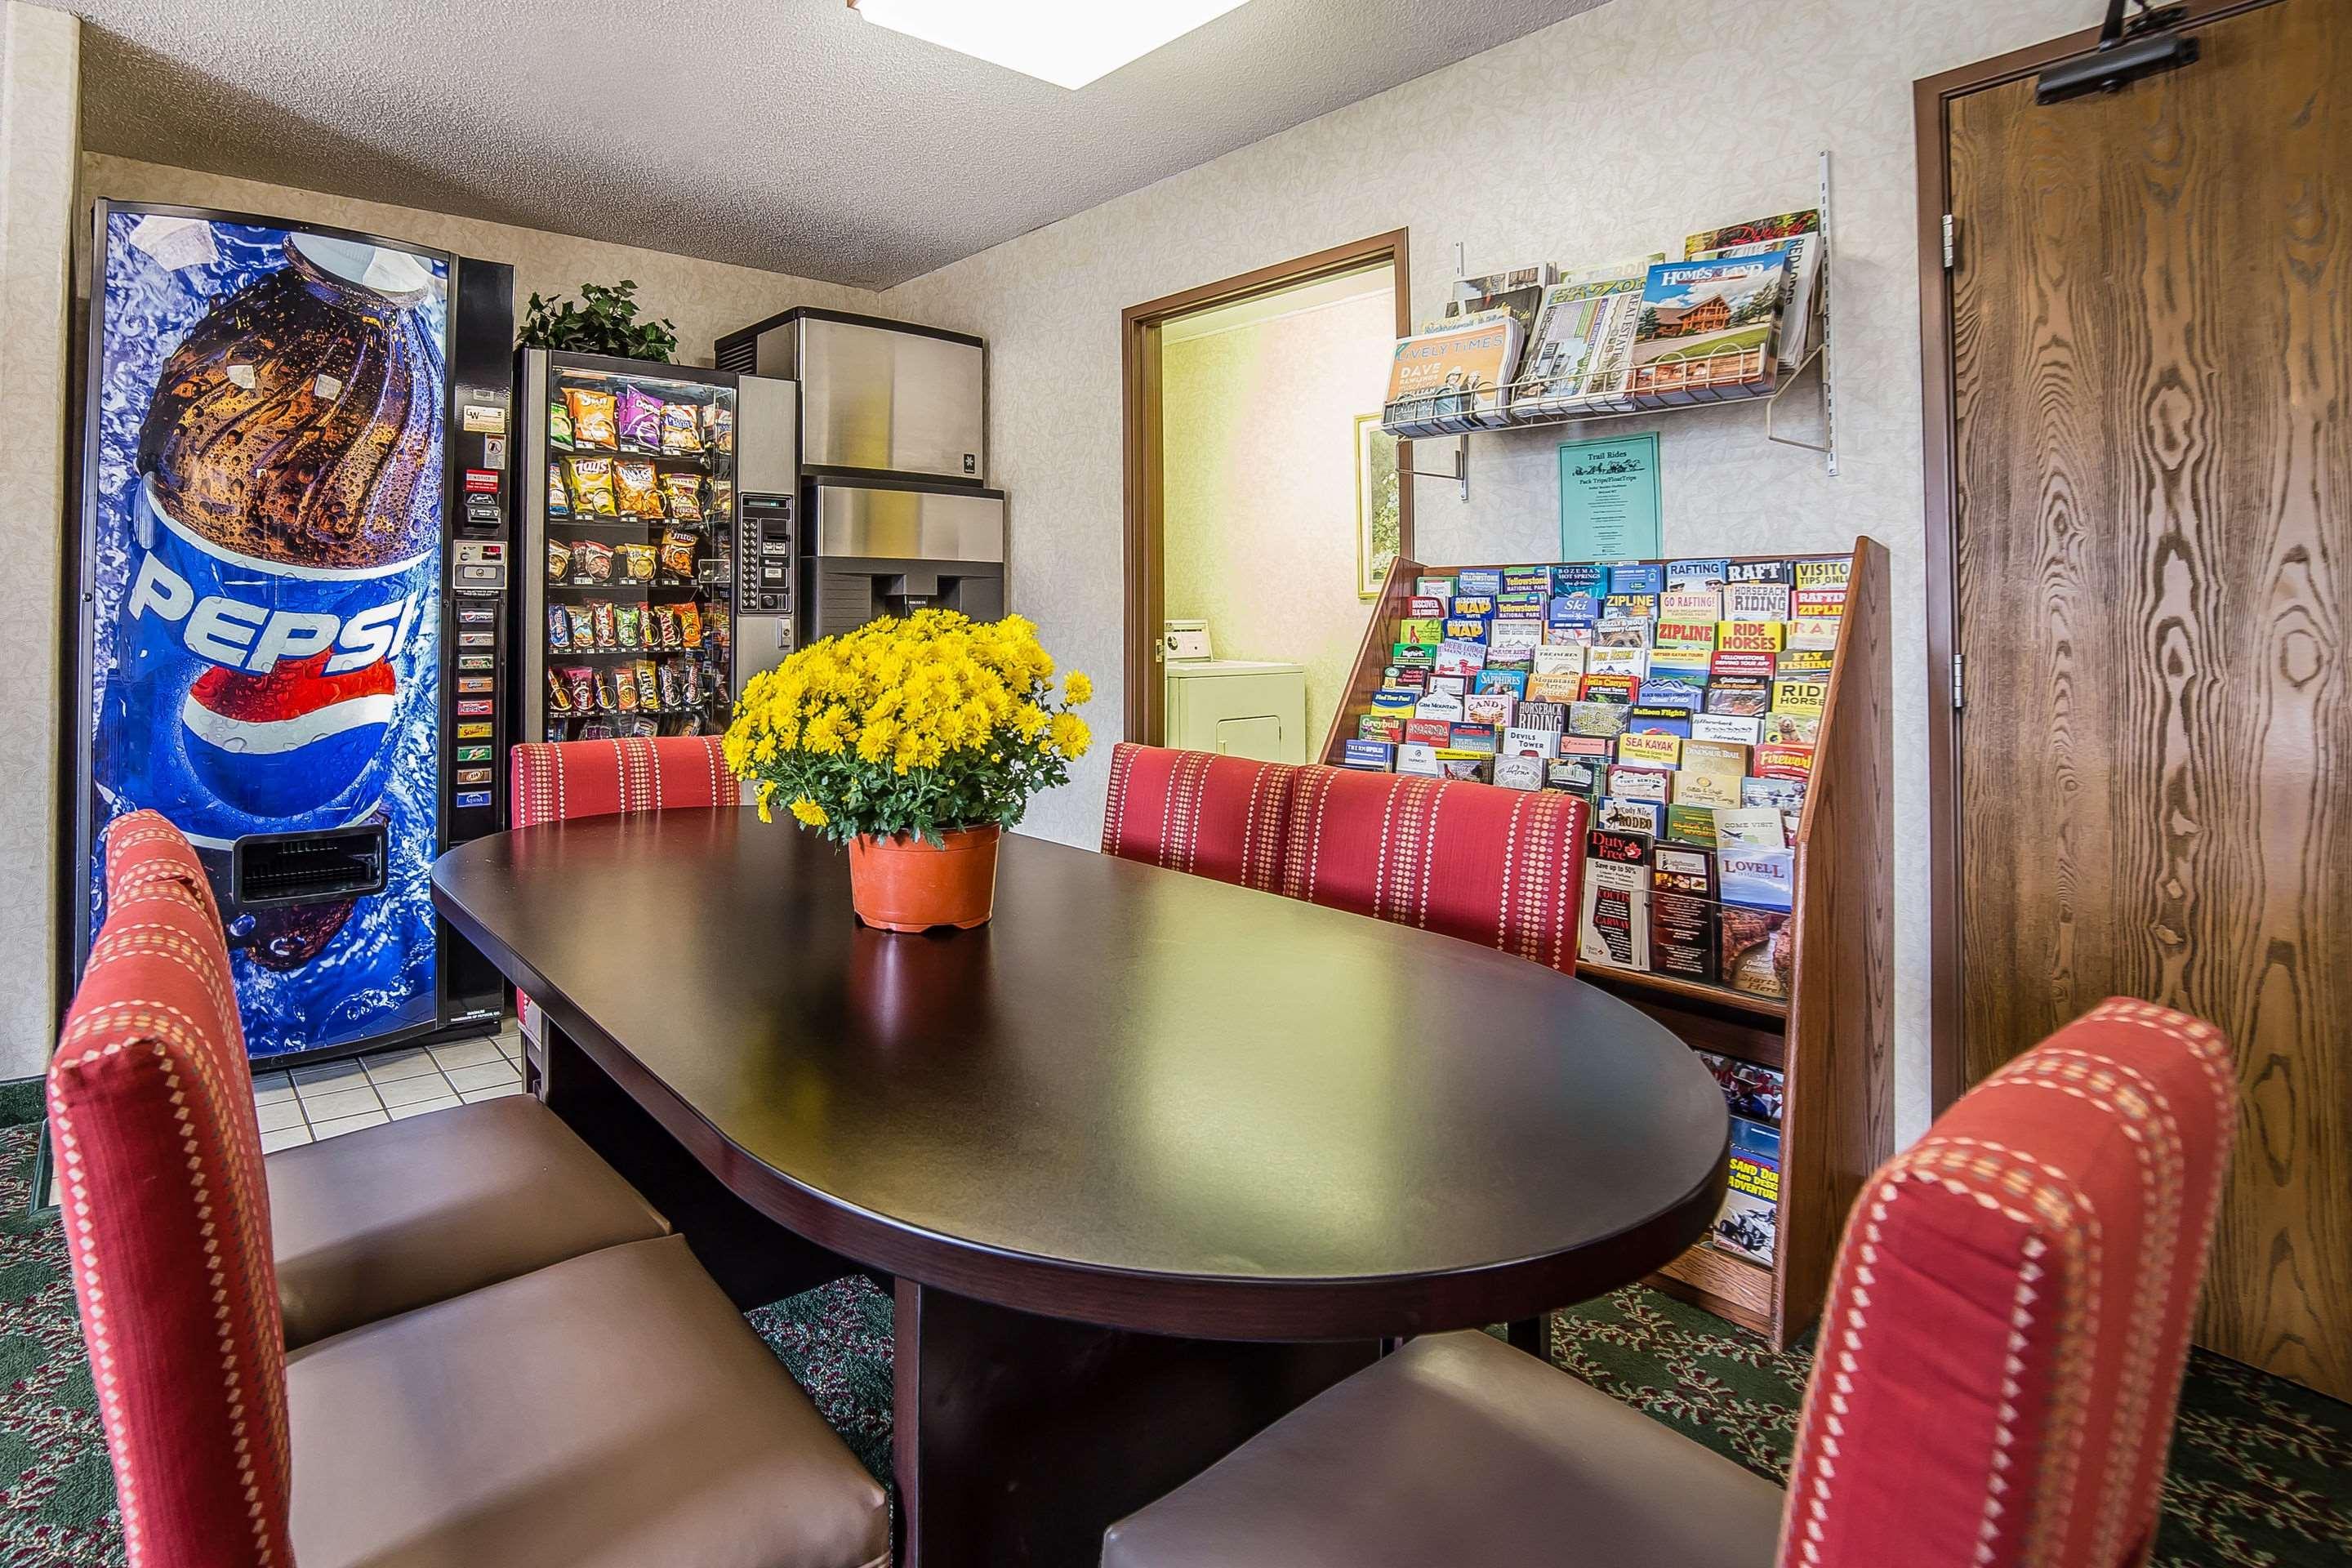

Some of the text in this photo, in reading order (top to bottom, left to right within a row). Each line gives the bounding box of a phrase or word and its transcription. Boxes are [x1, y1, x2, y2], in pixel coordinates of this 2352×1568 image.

[1660, 266, 1713, 287] HOMES
[1722, 263, 1765, 278] LAND
[1613, 294, 1641, 359] REAL ESTATE
[1401, 362, 1441, 379] DAVE
[1670, 564, 1719, 575] RAFTING
[1726, 562, 1781, 582] RAFT
[1506, 577, 1548, 586] Yellowstone
[1800, 577, 1820, 585] TIPS
[1734, 586, 1786, 596] HORSEBACK
[1411, 599, 1439, 608] DISCOVER
[1565, 599, 1588, 611] Ski
[1606, 594, 1655, 607] ZIPLINE
[1664, 596, 1715, 608] GO RAFTING!
[1735, 595, 1786, 612] RIDING
[127, 551, 419, 676] PEPSI
[1454, 602, 1491, 614] MAP
[1499, 604, 1540, 612] Yellowstone
[1447, 626, 1484, 637] MAP
[1659, 623, 1713, 642] ZIPLINE
[1733, 623, 1765, 636] RIDE
[1444, 640, 1485, 653] DEER LODGE
[1722, 636, 1776, 650] HORSES
[1443, 647, 1483, 659] MONTANA
[1793, 652, 1823, 661] FLY
[1481, 672, 1521, 685] SAPPHIRES
[1534, 676, 1576, 684] Mountain
[1604, 679, 1633, 688] Canyon
[1535, 688, 1568, 699] Pottery
[1468, 700, 1507, 711] CANDY
[1519, 702, 1563, 715] HORSEBACK
[1633, 708, 1686, 718] Balloon Flights
[1362, 718, 1400, 729] Greybull
[1519, 715, 1563, 733] RIDING
[1408, 724, 1450, 736] ANACONDA
[1510, 732, 1536, 741] DEVILS
[1347, 744, 1384, 754] THERMOPOLIS
[1519, 740, 1544, 749] TOWER
[1625, 737, 1673, 751] SEA KAYAK
[1686, 747, 1740, 760] DINOSAUR TRAIL
[1621, 805, 1652, 817] Cody Nite
[1619, 816, 1653, 830] RODEO
[1592, 831, 1625, 849] Duty
[1599, 845, 1626, 861] Free
[1595, 861, 1608, 870] Save
[1723, 859, 1784, 879] LOVELL
[1597, 889, 1631, 902] COUTTS
[1594, 915, 1630, 929] CARWAY
[1730, 1159, 1757, 1175] SAND
[1736, 1173, 1752, 1182] AND
